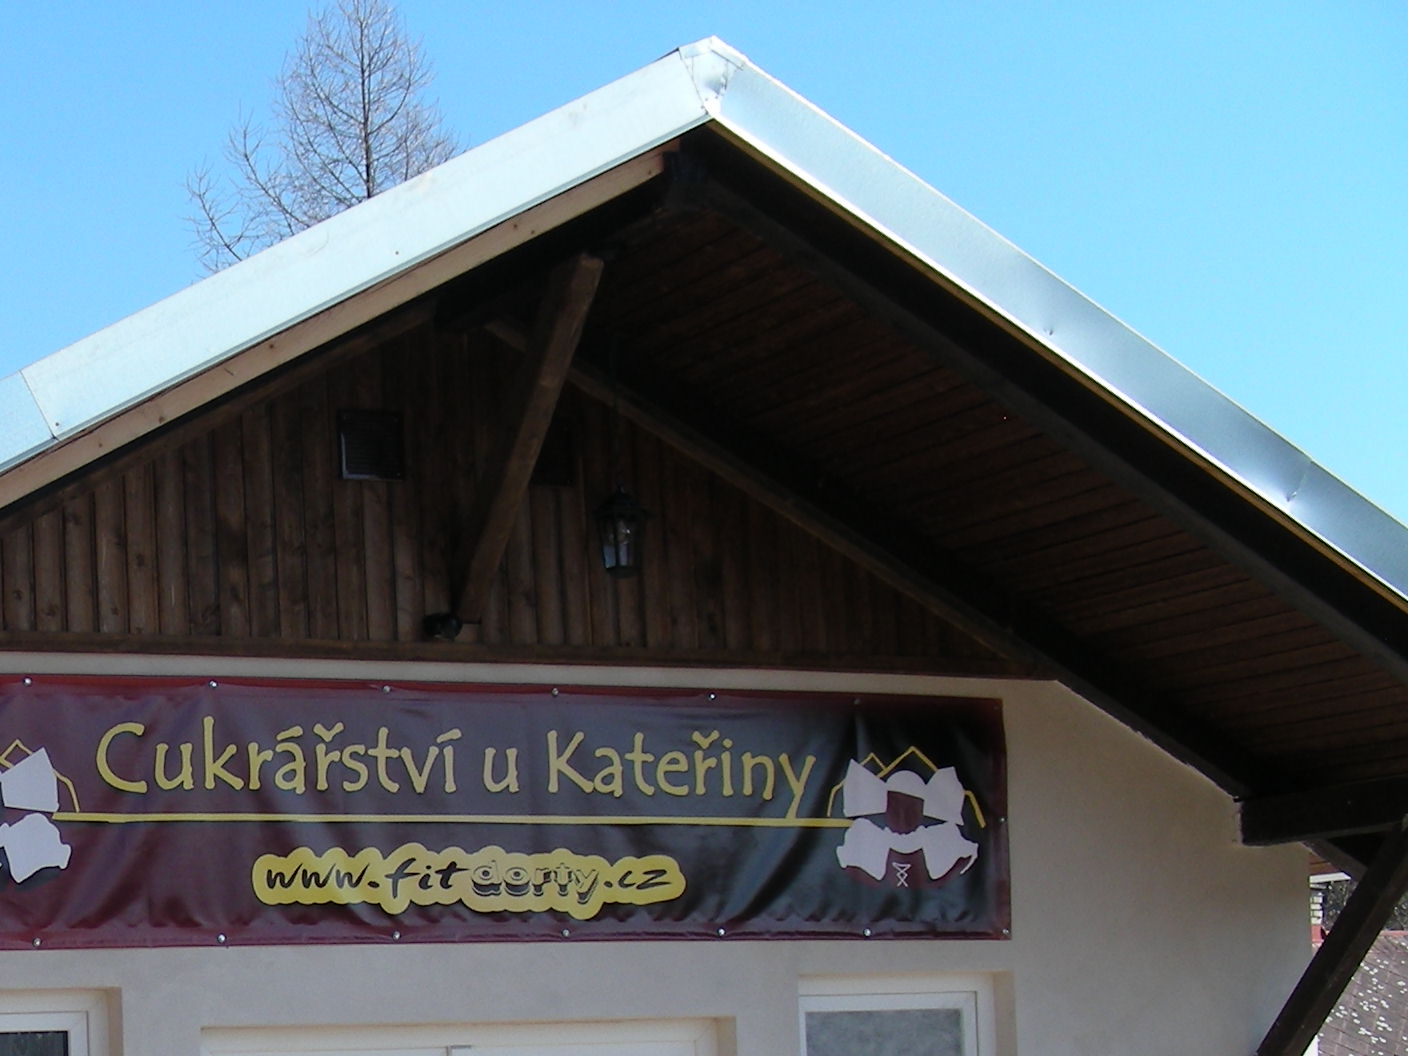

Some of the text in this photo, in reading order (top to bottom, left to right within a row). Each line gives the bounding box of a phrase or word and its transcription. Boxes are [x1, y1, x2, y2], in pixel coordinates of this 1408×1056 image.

[96, 716, 816, 818] Cukrářství u Kateřiny
[265, 857, 673, 904] www.fitdorty.cz
